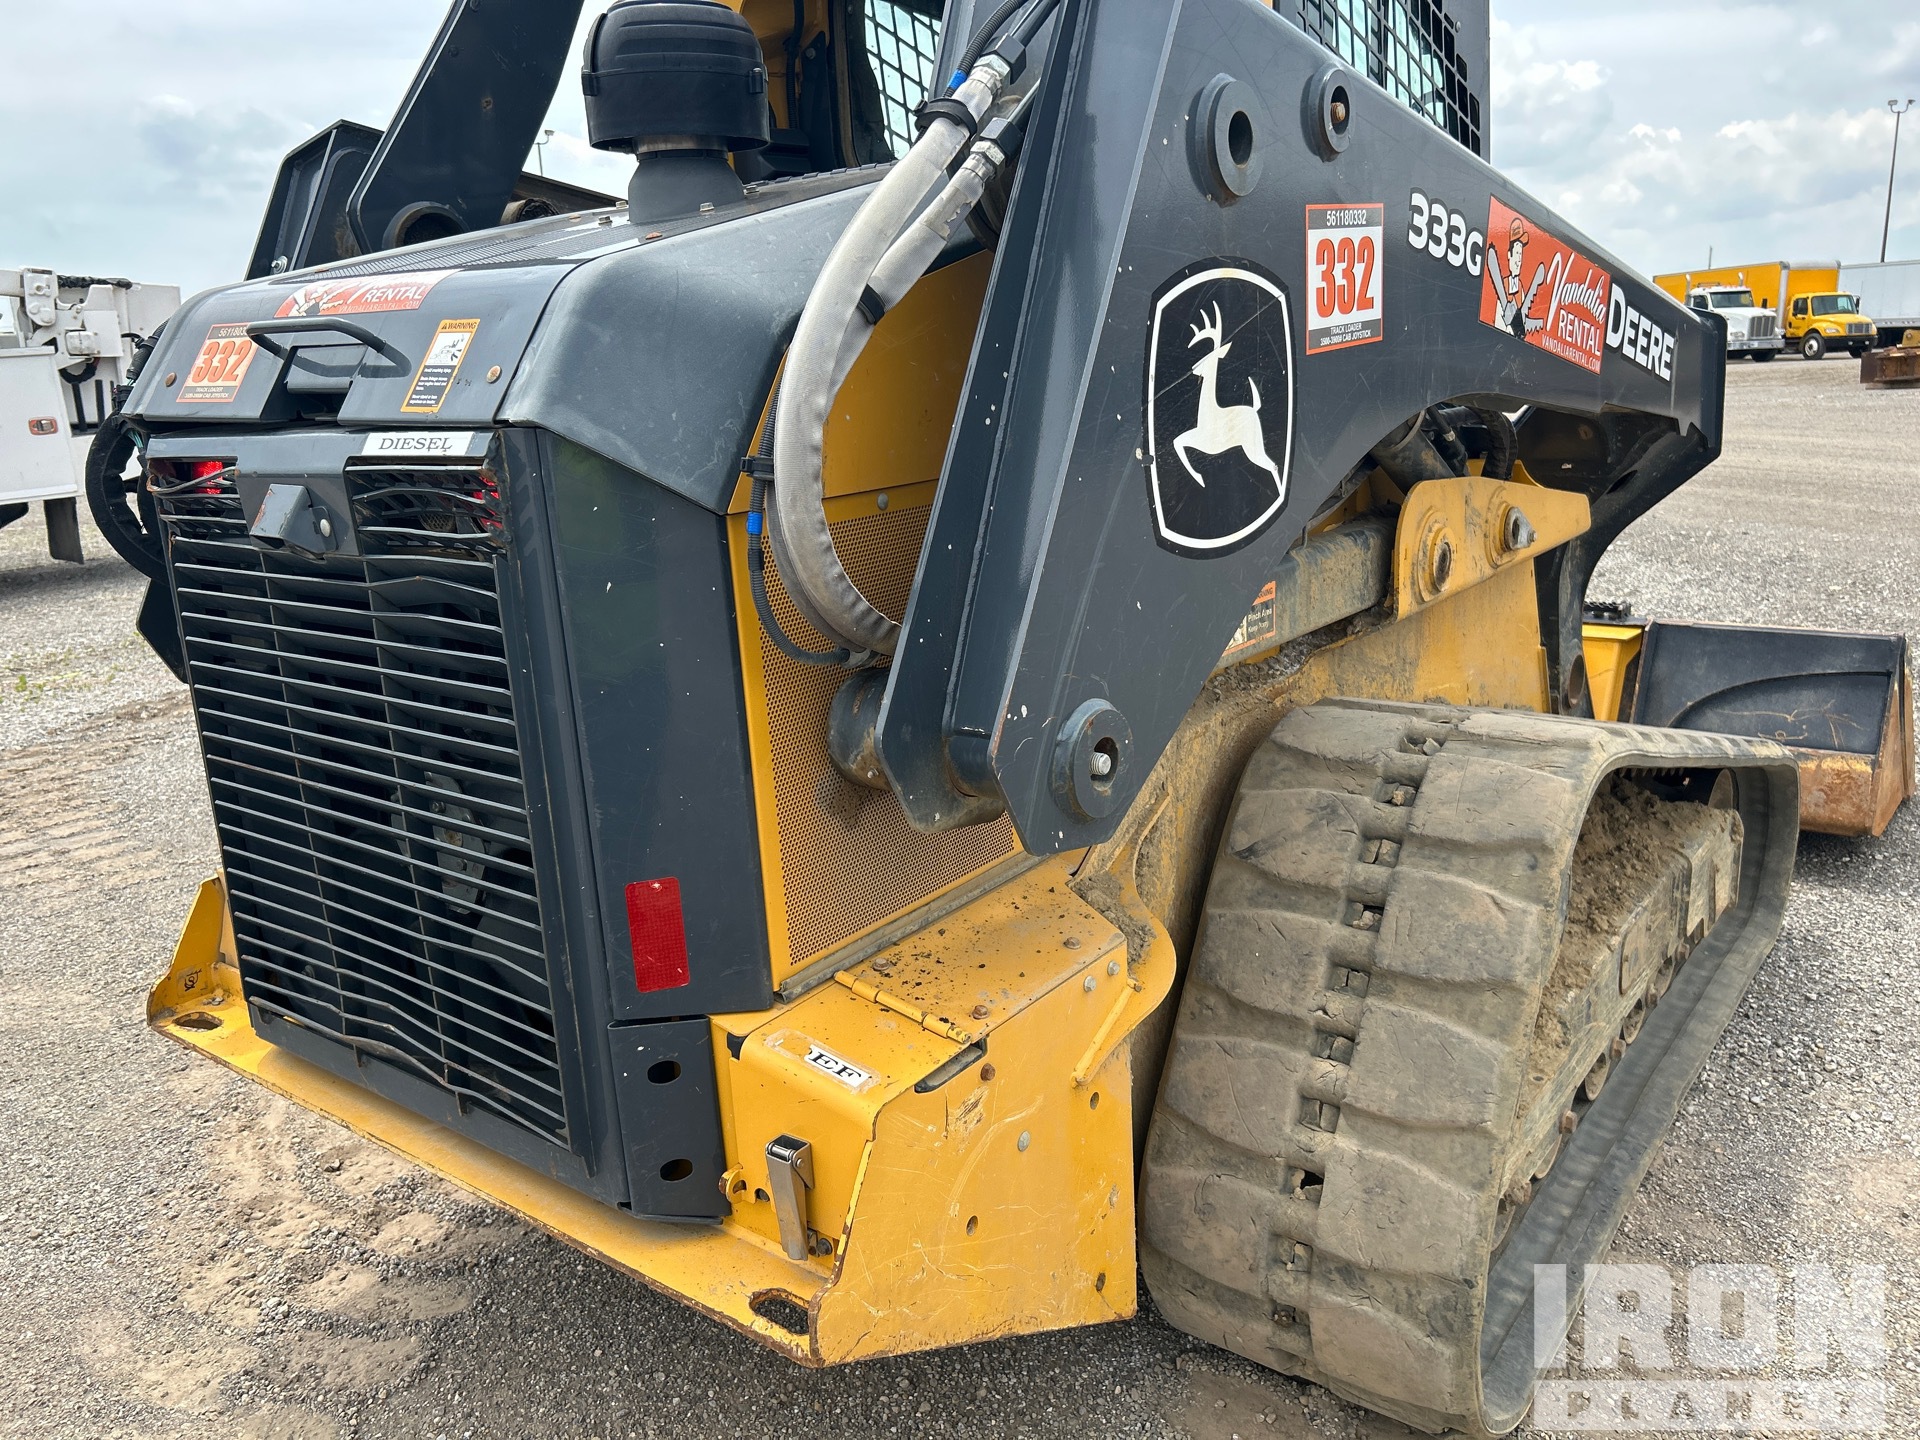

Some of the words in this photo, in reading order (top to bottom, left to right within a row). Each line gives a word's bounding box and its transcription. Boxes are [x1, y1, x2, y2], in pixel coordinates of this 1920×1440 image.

[1326, 210, 1367, 226] 561180332
[1408, 193, 1483, 276] 333G
[361, 285, 425, 303] RENTAL
[1315, 235, 1374, 318] 332
[1546, 251, 1607, 331] Vandalia
[447, 322, 477, 330] WARNING
[1330, 325, 1345, 335] TRACK
[1345, 323, 1362, 333] LOADER
[1558, 308, 1601, 356] RENTAL
[1605, 283, 1675, 382] DEERE
[191, 340, 253, 383] 332
[1542, 334, 1600, 374] VANDALIARENTAL.COM
[378, 438, 453, 450] DIESEL
